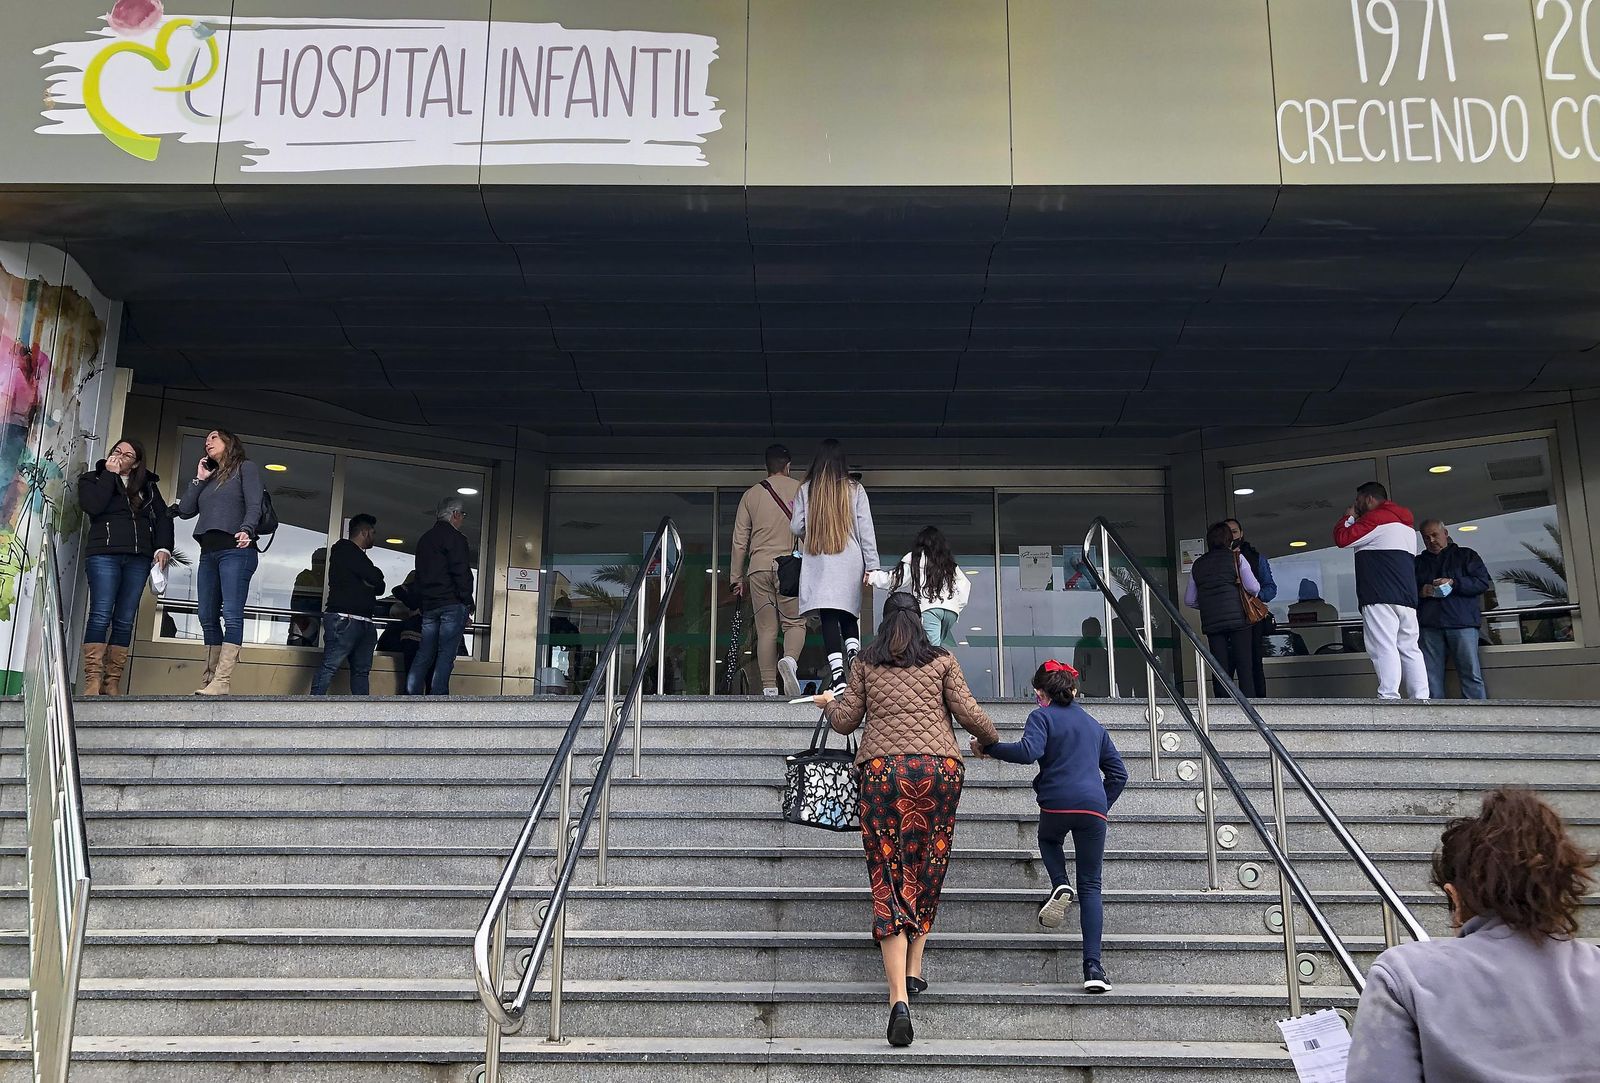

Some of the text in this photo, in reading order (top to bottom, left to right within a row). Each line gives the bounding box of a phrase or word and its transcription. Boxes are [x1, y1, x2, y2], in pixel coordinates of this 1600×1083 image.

[1483, 32, 1509, 42] -
[254, 44, 700, 118] HOSPITAL INFANTIL
[1276, 94, 1529, 164] CRECIENDO
